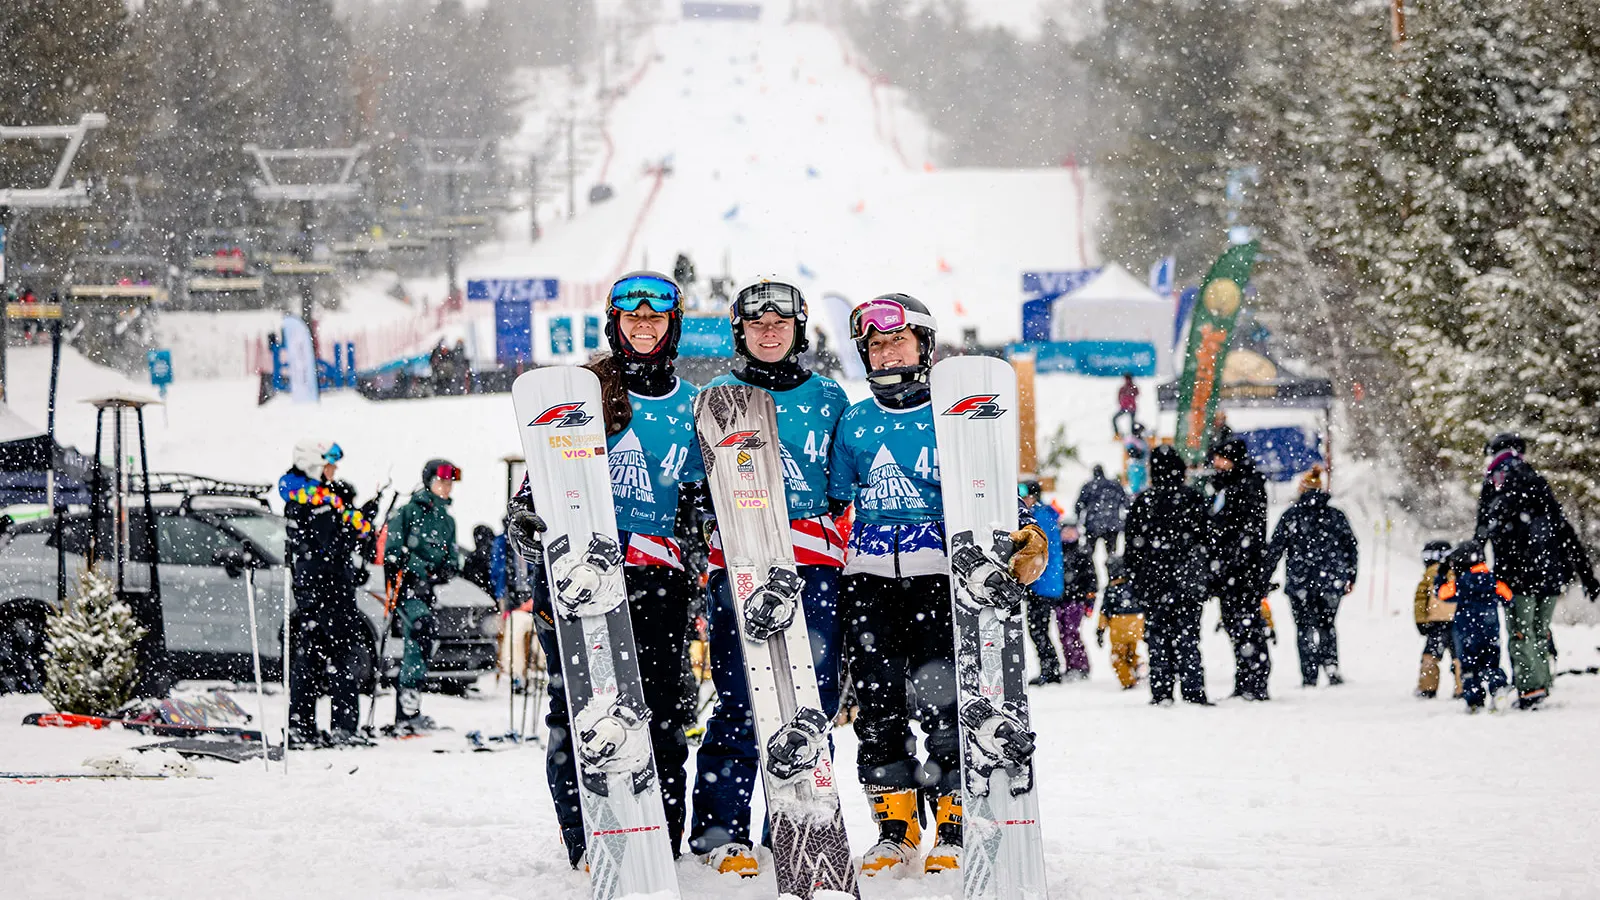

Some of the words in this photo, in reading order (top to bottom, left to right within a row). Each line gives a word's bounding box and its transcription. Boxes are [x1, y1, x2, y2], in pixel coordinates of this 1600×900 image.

[485, 279, 547, 299] VISA
[820, 380, 838, 388] VISA
[527, 401, 595, 428] F2
[941, 394, 1008, 419] F2
[854, 422, 930, 438] VOLV
[714, 430, 767, 450] F2
[803, 430, 830, 464] 44
[660, 443, 689, 480] 48
[609, 465, 653, 492] ORD
[740, 472, 754, 480] RS
[972, 479, 985, 488] RS
[566, 490, 580, 498] RS
[733, 489, 769, 498] PROTO
[993, 533, 1012, 543] VIS
